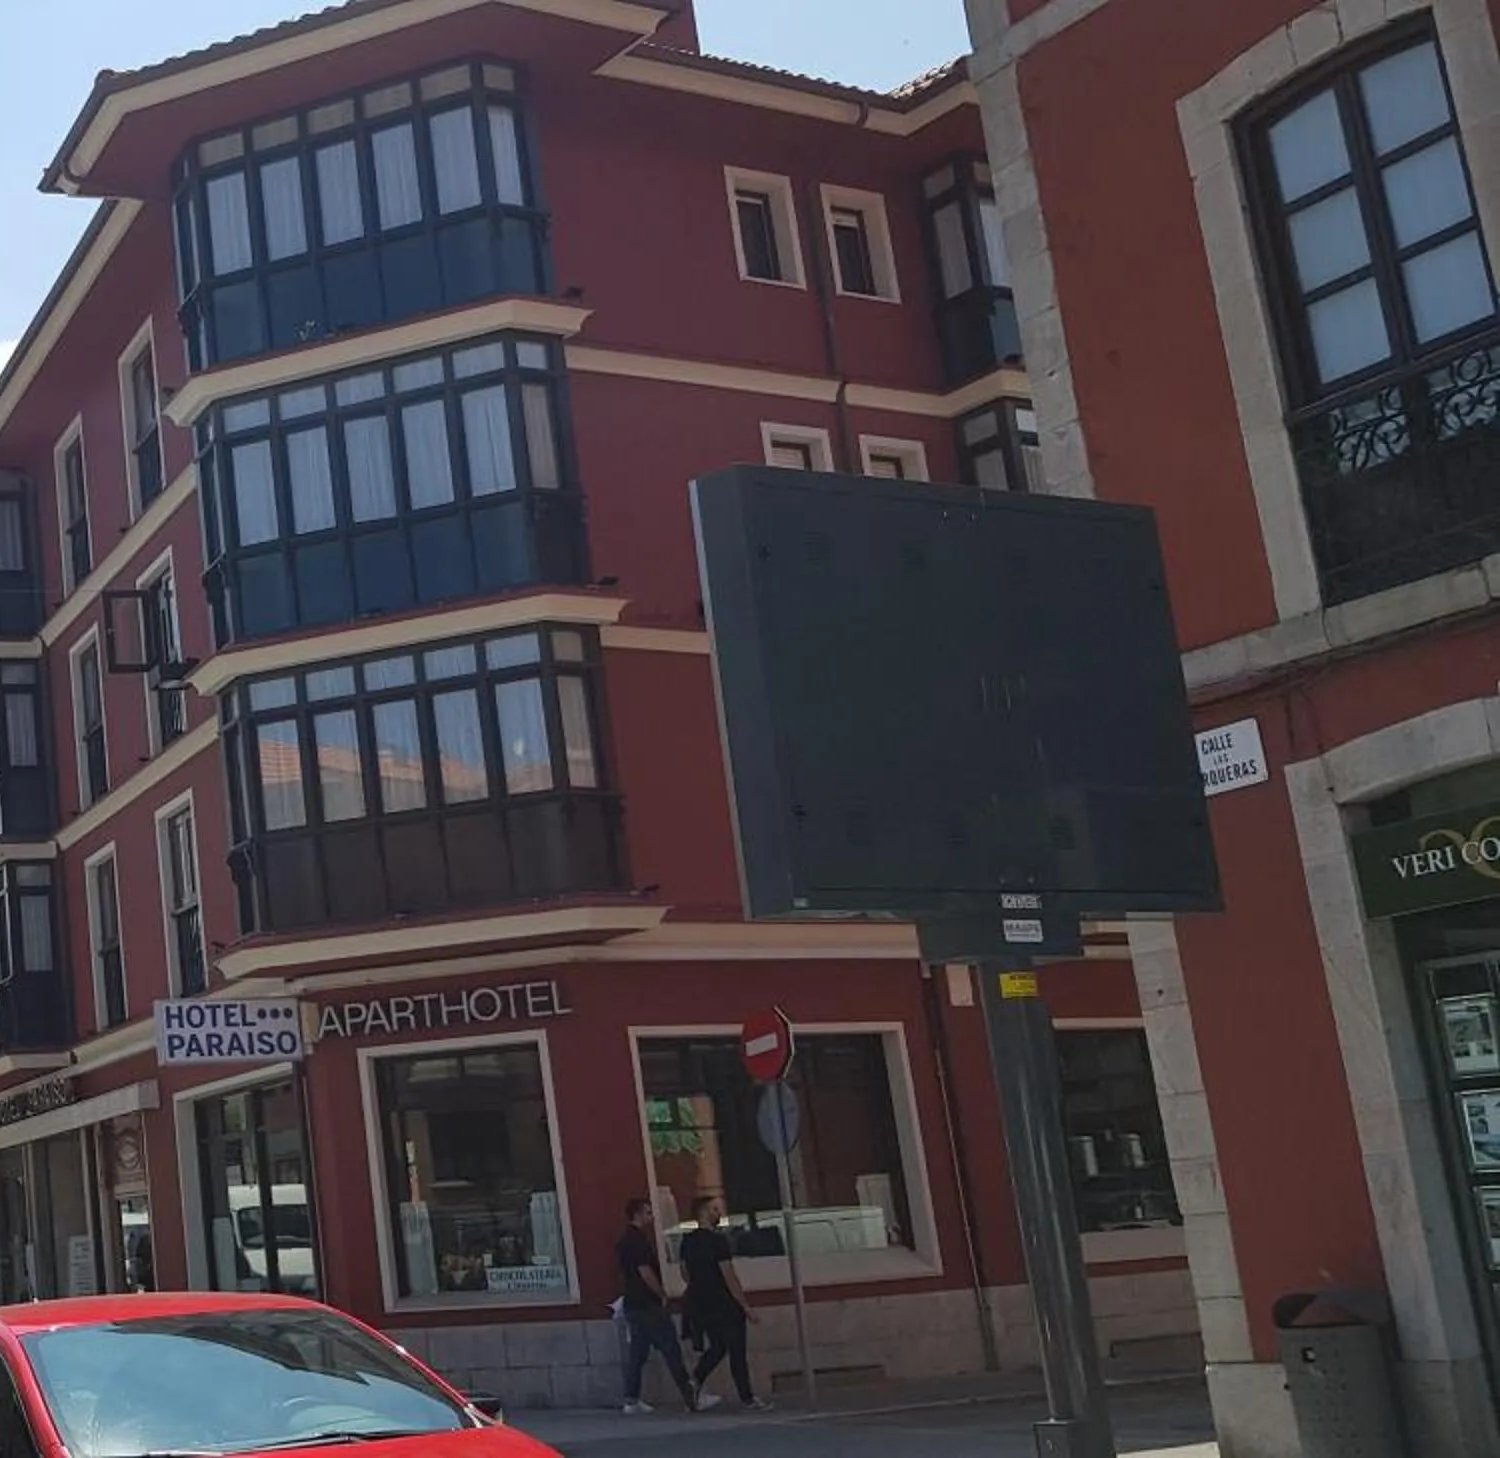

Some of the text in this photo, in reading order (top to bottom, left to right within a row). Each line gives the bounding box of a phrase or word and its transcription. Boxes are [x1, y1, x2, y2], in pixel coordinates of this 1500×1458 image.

[1201, 732, 1232, 755] CALLE
[1203, 759, 1257, 787] RQUERAS
[1392, 846, 1456, 879] VERI
[165, 1003, 257, 1029] HOTEL
[318, 981, 573, 1039] APARTHOTEL
[167, 1030, 298, 1059] PARAISO
